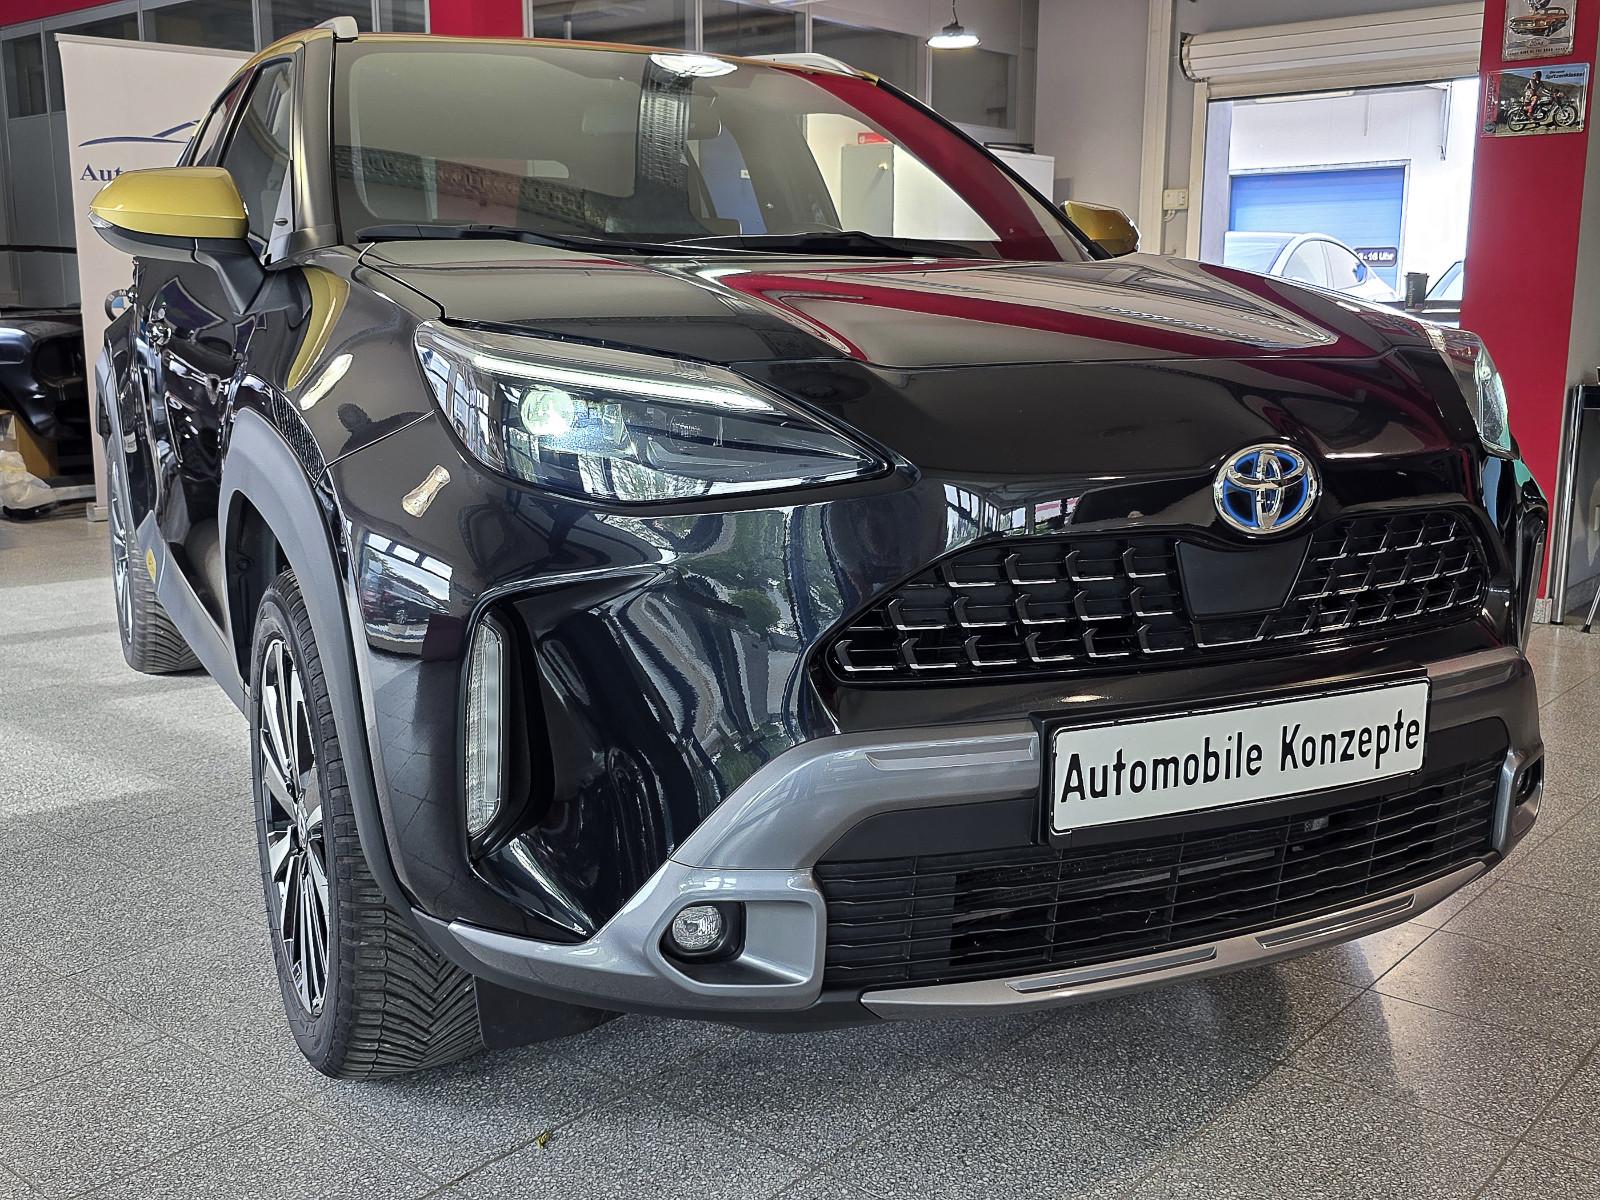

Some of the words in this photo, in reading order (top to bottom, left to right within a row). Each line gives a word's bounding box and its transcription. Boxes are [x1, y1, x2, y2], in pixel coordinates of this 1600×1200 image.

[1379, 251, 1394, 261] Uhr
[1060, 731, 1262, 803] Automobile
[1280, 708, 1420, 771] Konzepte
